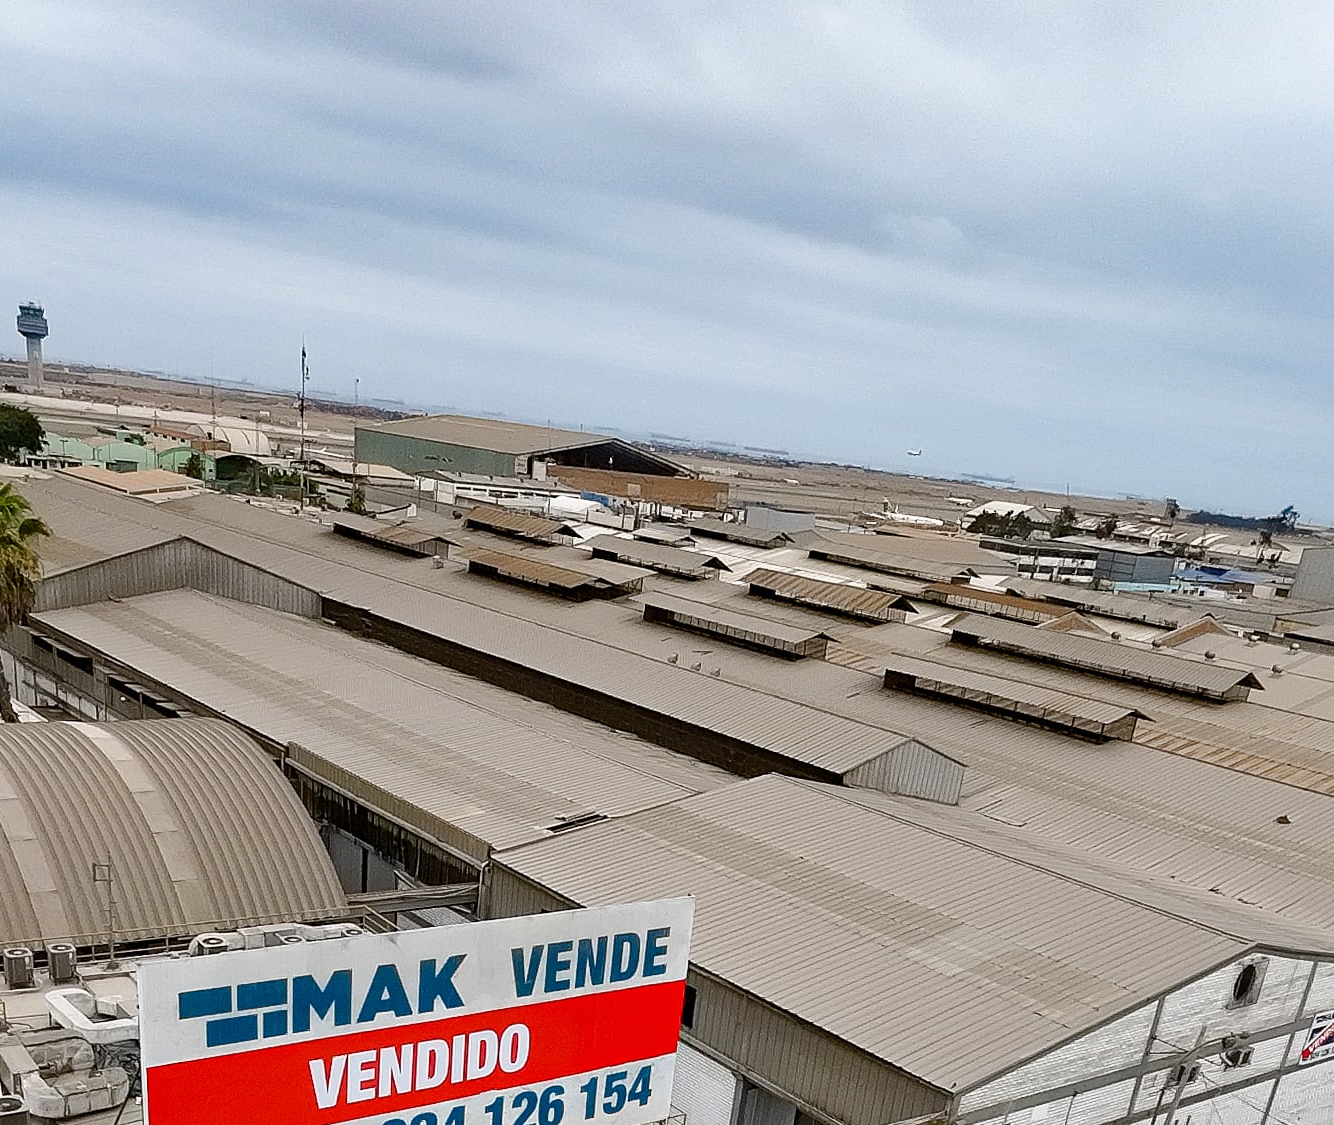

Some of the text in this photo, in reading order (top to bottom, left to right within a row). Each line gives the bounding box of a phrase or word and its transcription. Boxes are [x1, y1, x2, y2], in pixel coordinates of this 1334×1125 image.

[292, 928, 670, 1033] MAK VENDE
[308, 1023, 531, 1110] VENDIDO
[579, 1066, 652, 1120] 154
